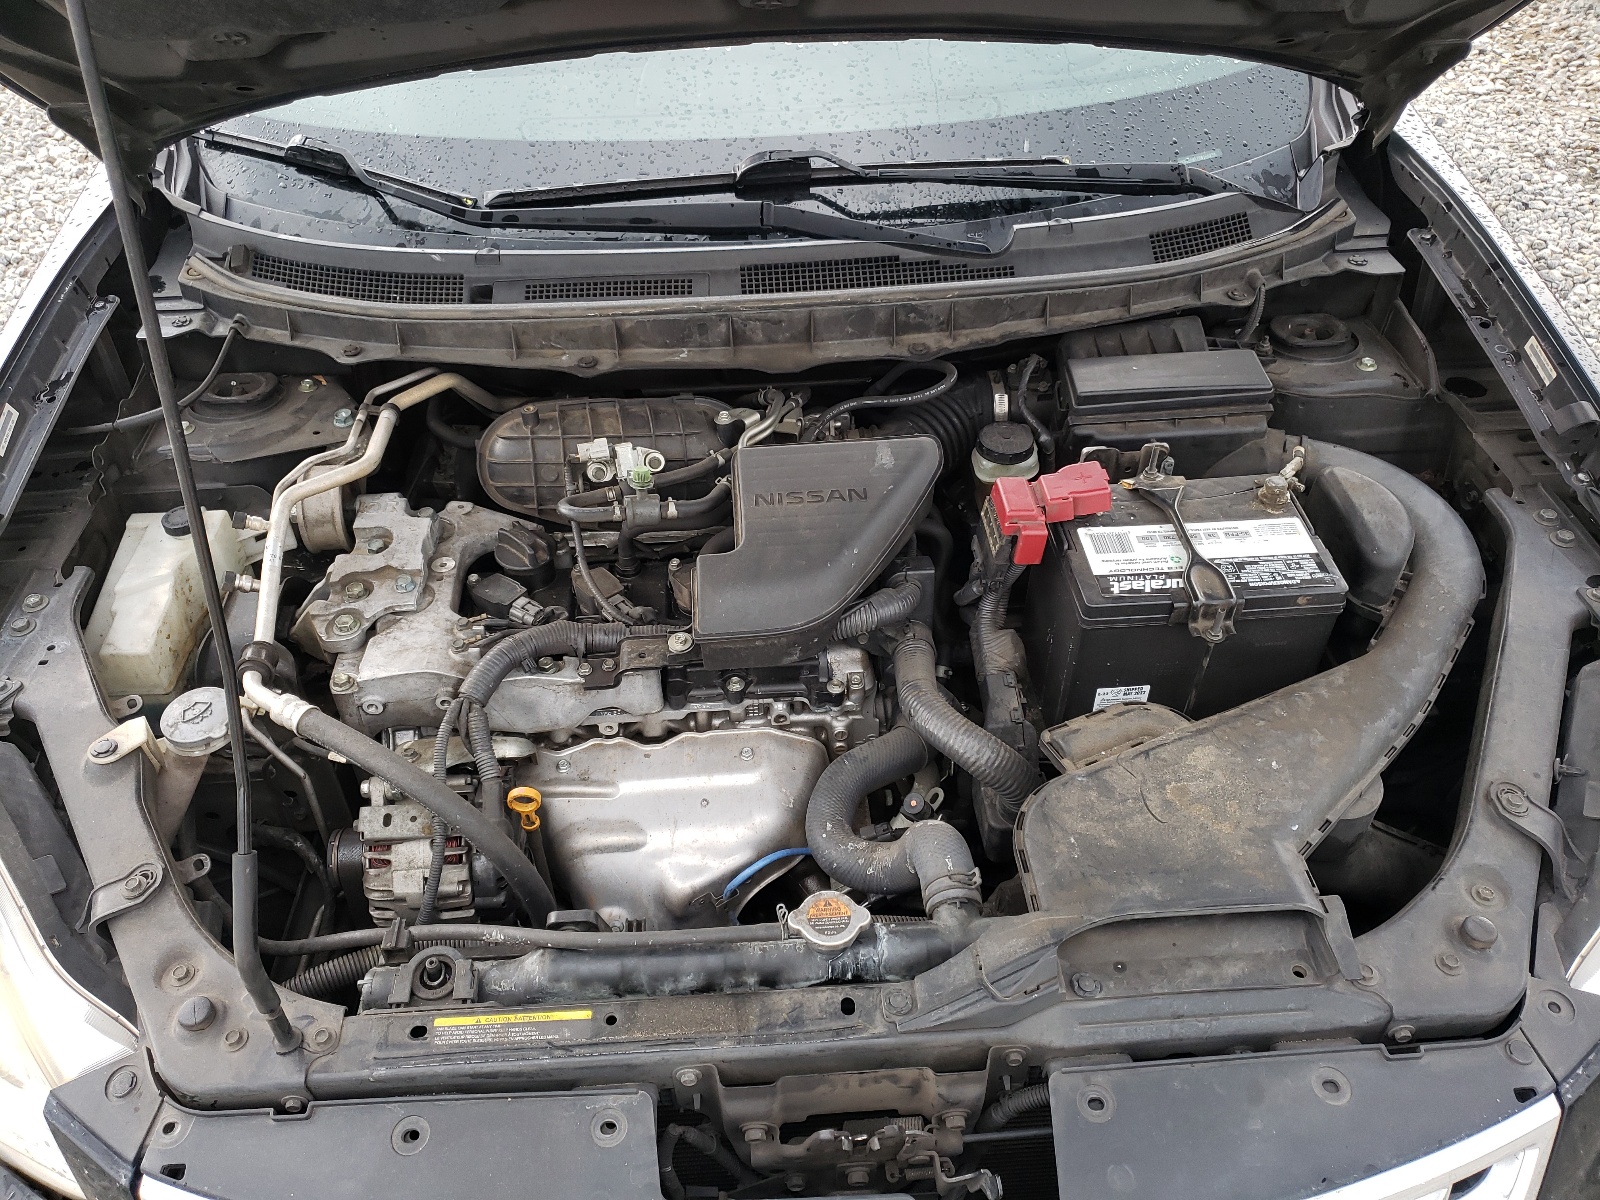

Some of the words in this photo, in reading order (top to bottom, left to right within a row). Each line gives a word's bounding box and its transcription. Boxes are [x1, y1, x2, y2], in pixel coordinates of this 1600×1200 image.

[754, 487, 868, 507] NISSAN
[1109, 574, 1165, 582] PLATINUM
[1110, 578, 1184, 594] uralast
